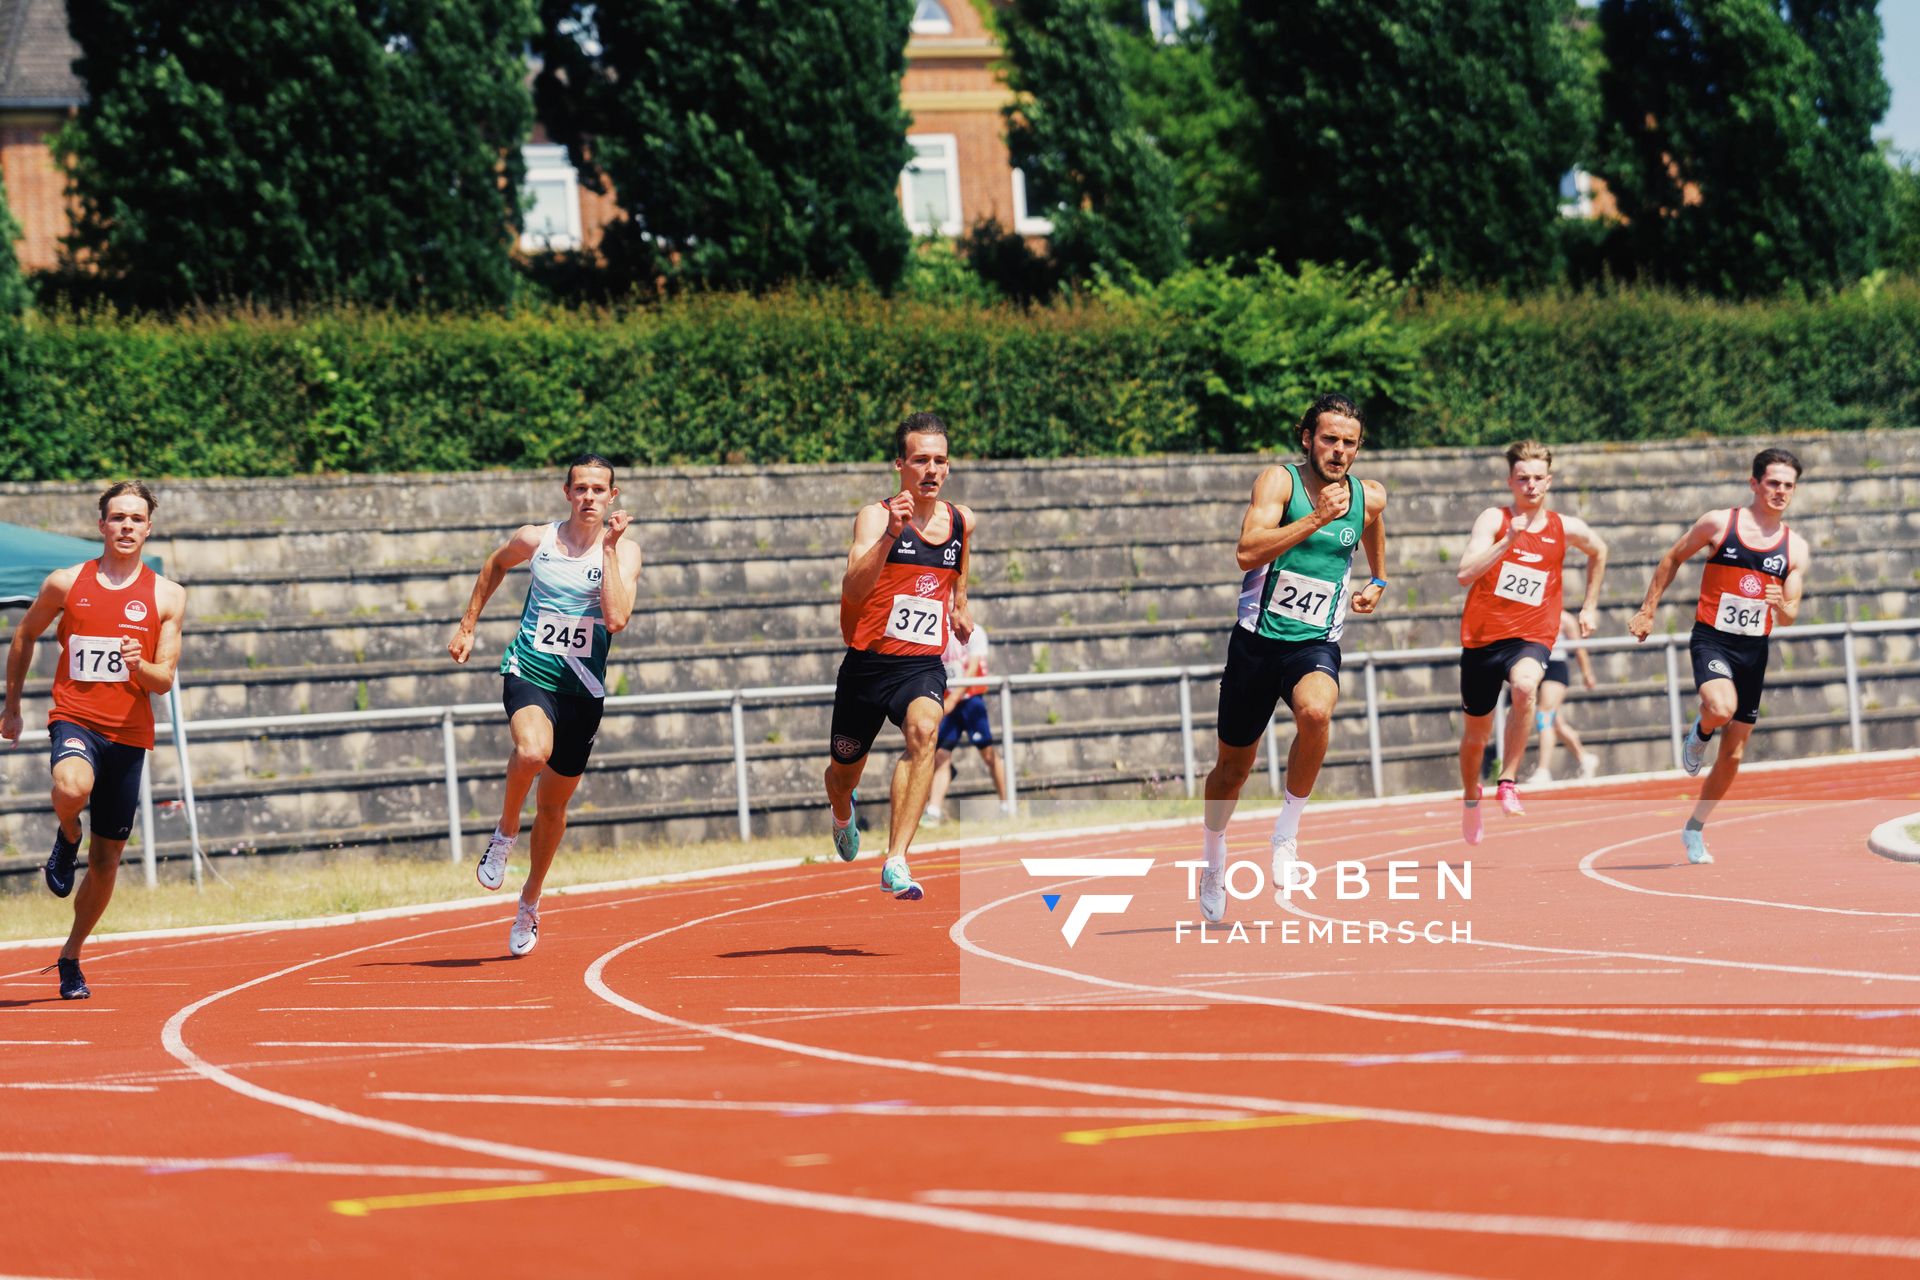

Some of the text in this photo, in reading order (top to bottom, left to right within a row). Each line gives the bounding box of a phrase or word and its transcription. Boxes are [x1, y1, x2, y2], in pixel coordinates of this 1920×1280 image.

[943, 548, 956, 561] OS
[1763, 557, 1780, 571] OS
[1503, 574, 1541, 597] 287
[1278, 586, 1327, 615] 247
[895, 608, 938, 636] 372
[1723, 605, 1761, 627] 364
[541, 624, 587, 648] 245
[75, 649, 122, 673] 178
